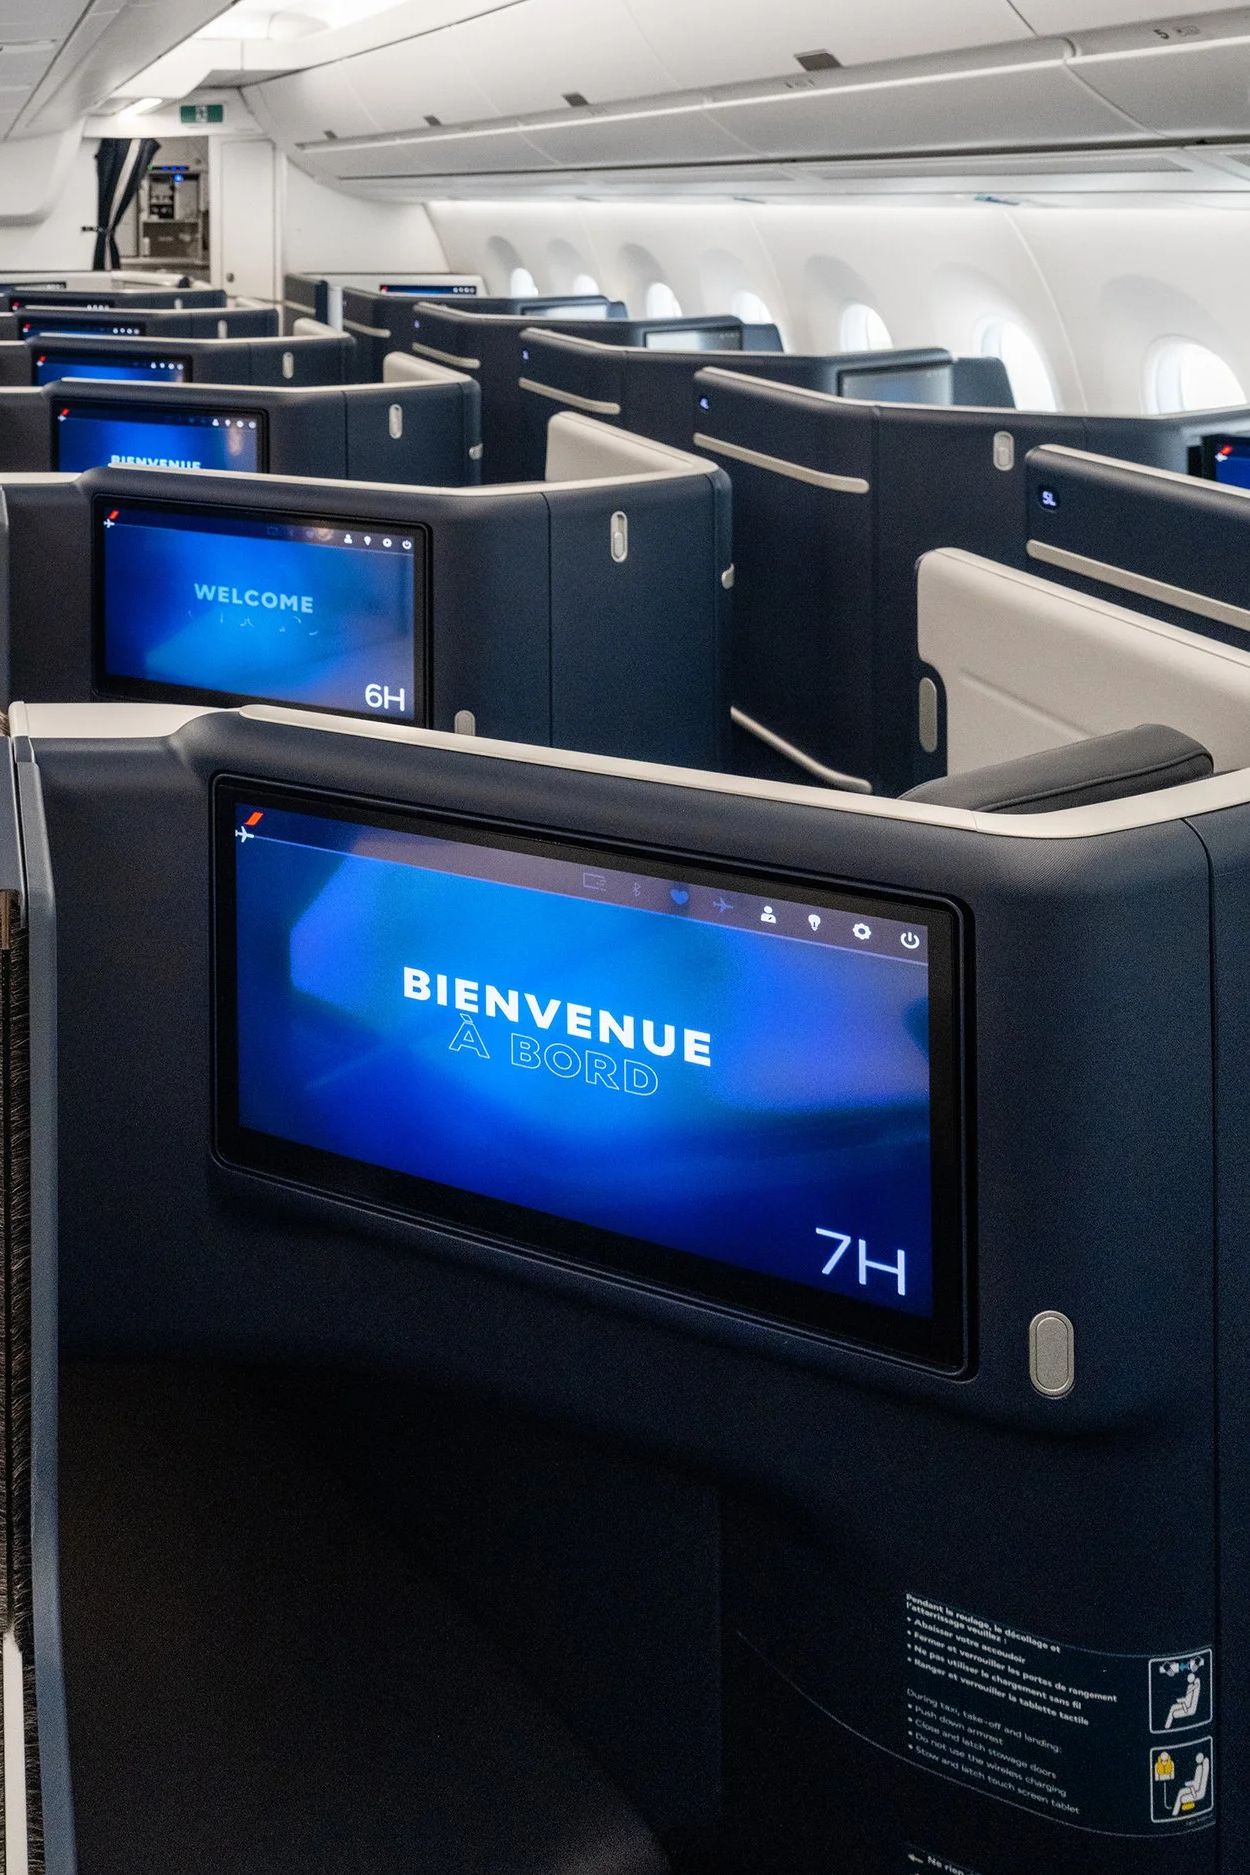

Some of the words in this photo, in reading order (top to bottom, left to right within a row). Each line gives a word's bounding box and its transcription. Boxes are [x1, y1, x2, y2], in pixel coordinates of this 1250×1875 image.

[194, 582, 314, 614] WELCOME
[364, 683, 405, 712] 6H
[403, 966, 711, 1067] BIENVENUE
[449, 1013, 490, 1059] À
[511, 1032, 658, 1096] BORD
[815, 1227, 906, 1296] 7H
